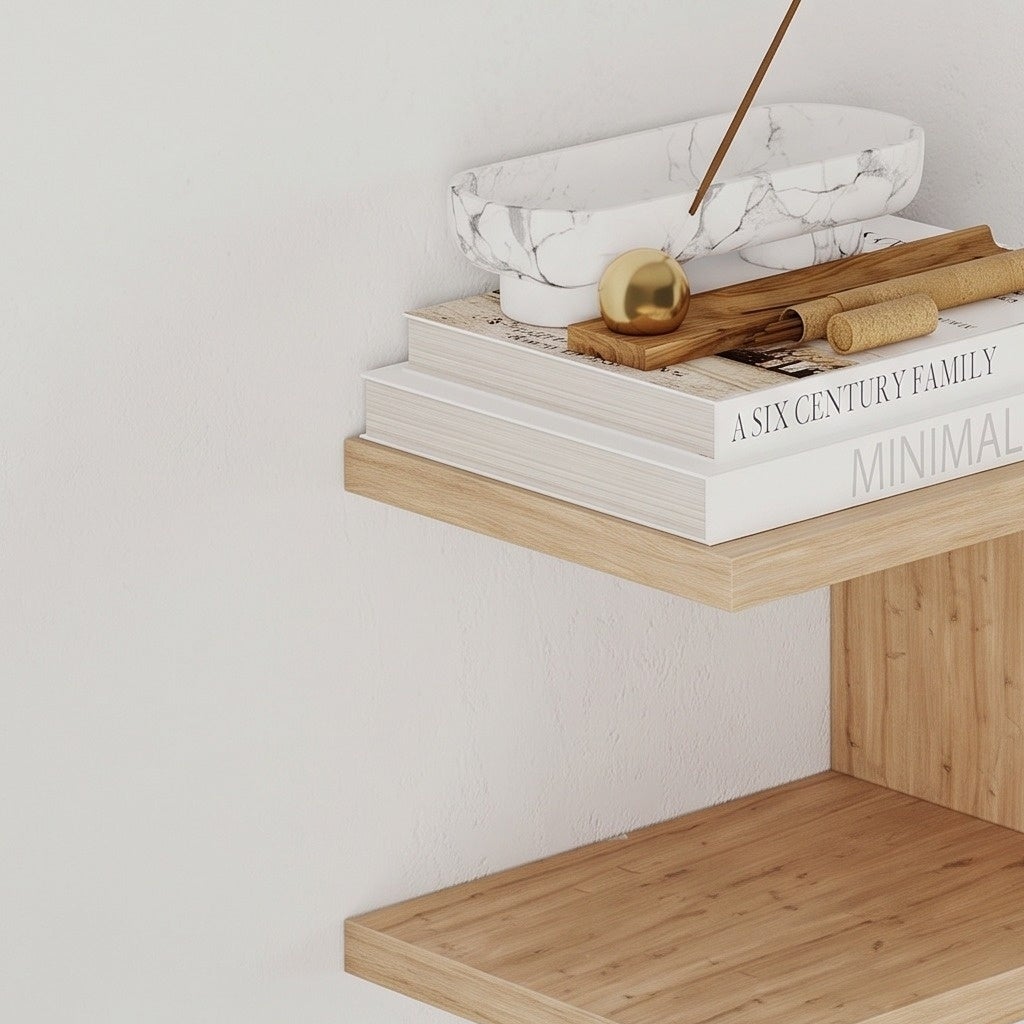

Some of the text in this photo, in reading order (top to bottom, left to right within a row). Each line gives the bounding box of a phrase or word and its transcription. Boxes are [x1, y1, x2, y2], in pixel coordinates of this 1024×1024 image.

[732, 346, 997, 442] A SIX CENTURY FAMILY
